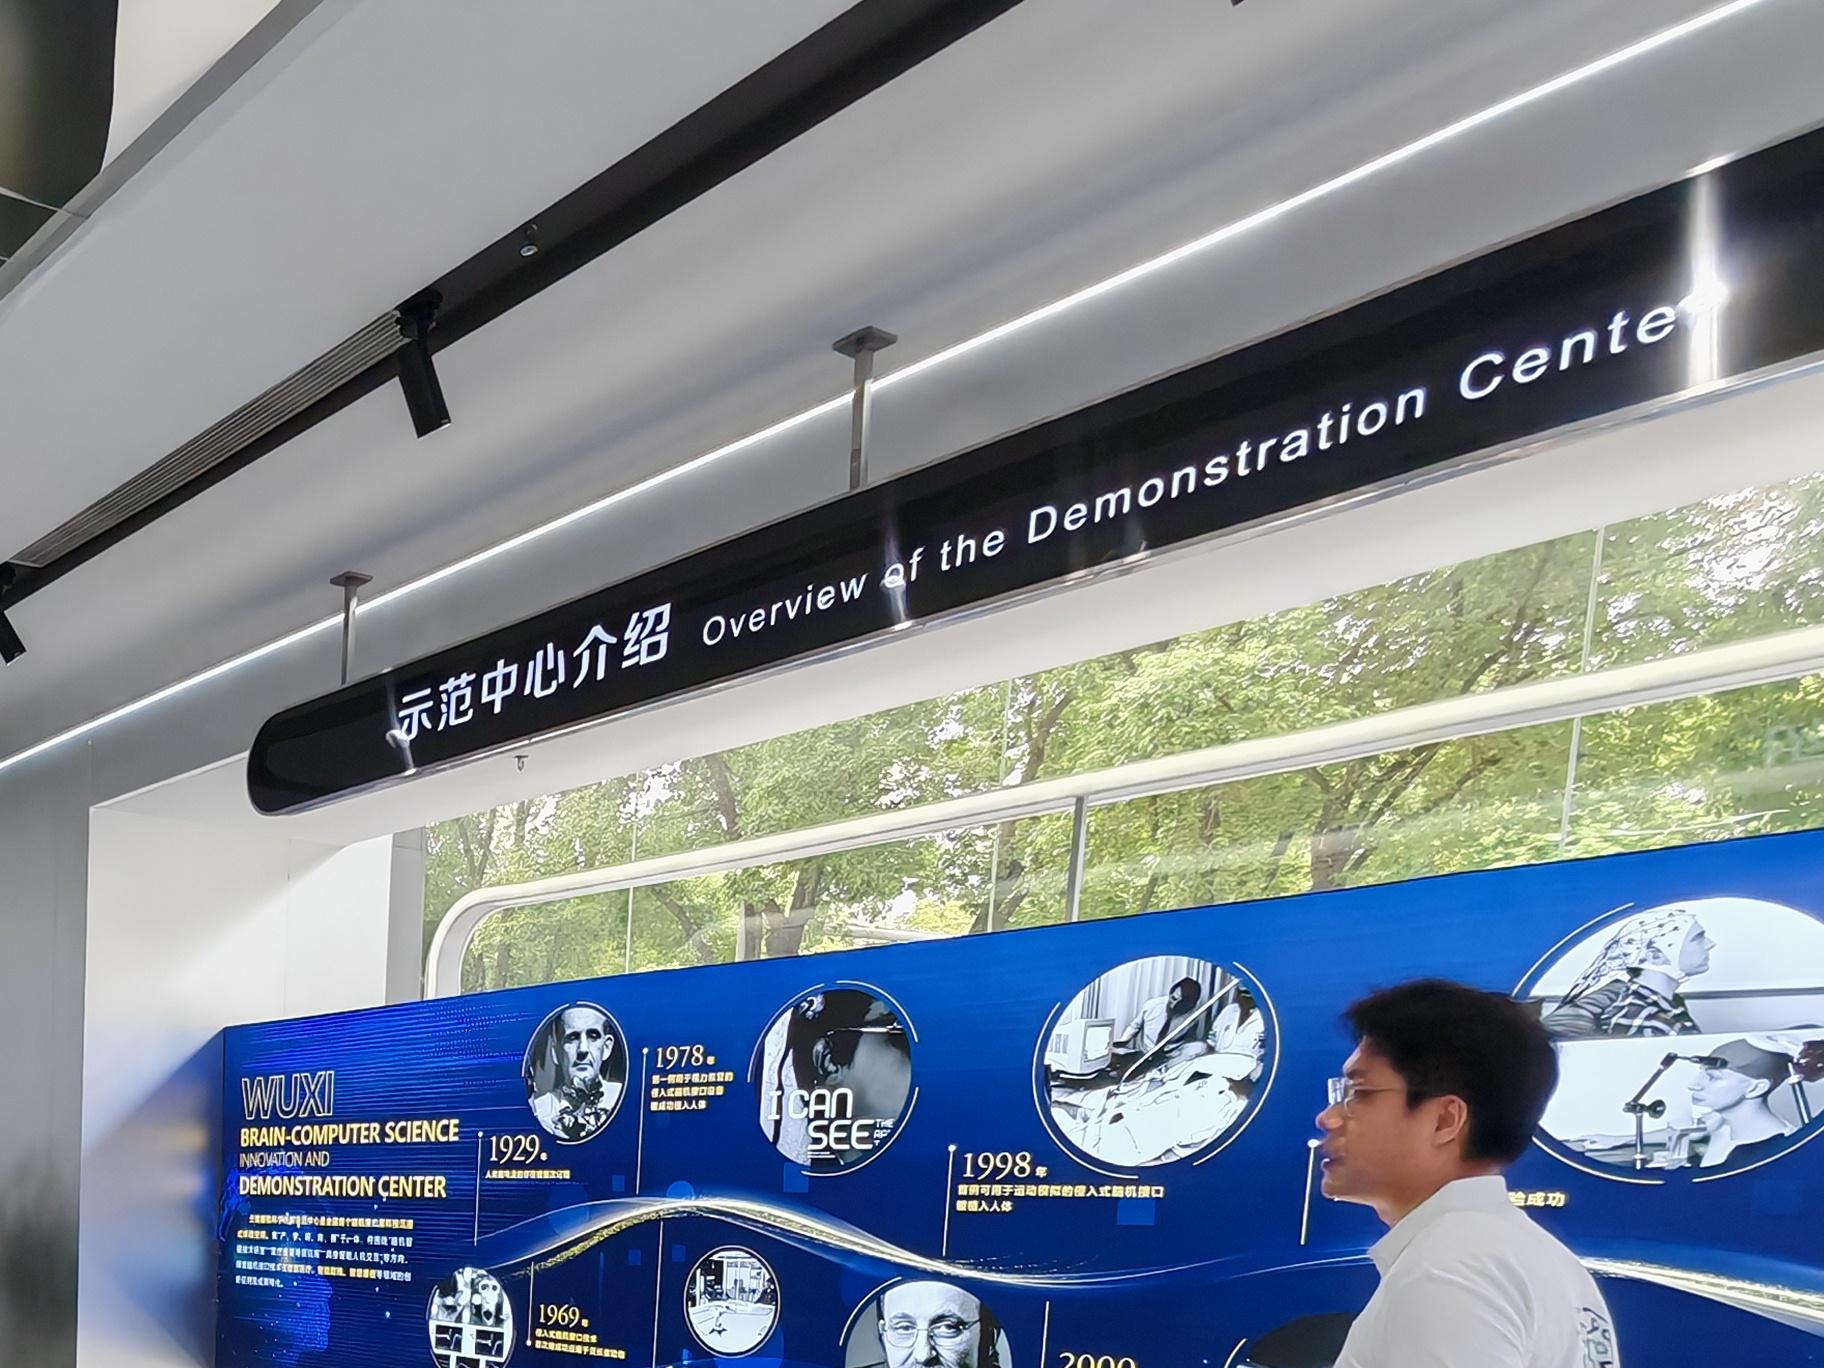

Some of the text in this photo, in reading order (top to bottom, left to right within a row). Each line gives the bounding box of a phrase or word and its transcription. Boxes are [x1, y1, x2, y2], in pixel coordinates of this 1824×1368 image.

[702, 572, 870, 646] Overview
[883, 546, 926, 589] of
[939, 530, 1005, 572] the
[1027, 385, 1427, 544] Demonstration
[397, 603, 671, 741] 示范中心介绍
[242, 1070, 335, 1120] WUXI
[767, 1087, 854, 1120] I CAN
[240, 1118, 460, 1147] BRAIN-COMPUTER SCIENCE
[807, 1119, 875, 1150] SEE
[239, 1150, 330, 1168] INNOVATION AND
[239, 1175, 447, 1198] DEMONSTRATION CENTER
